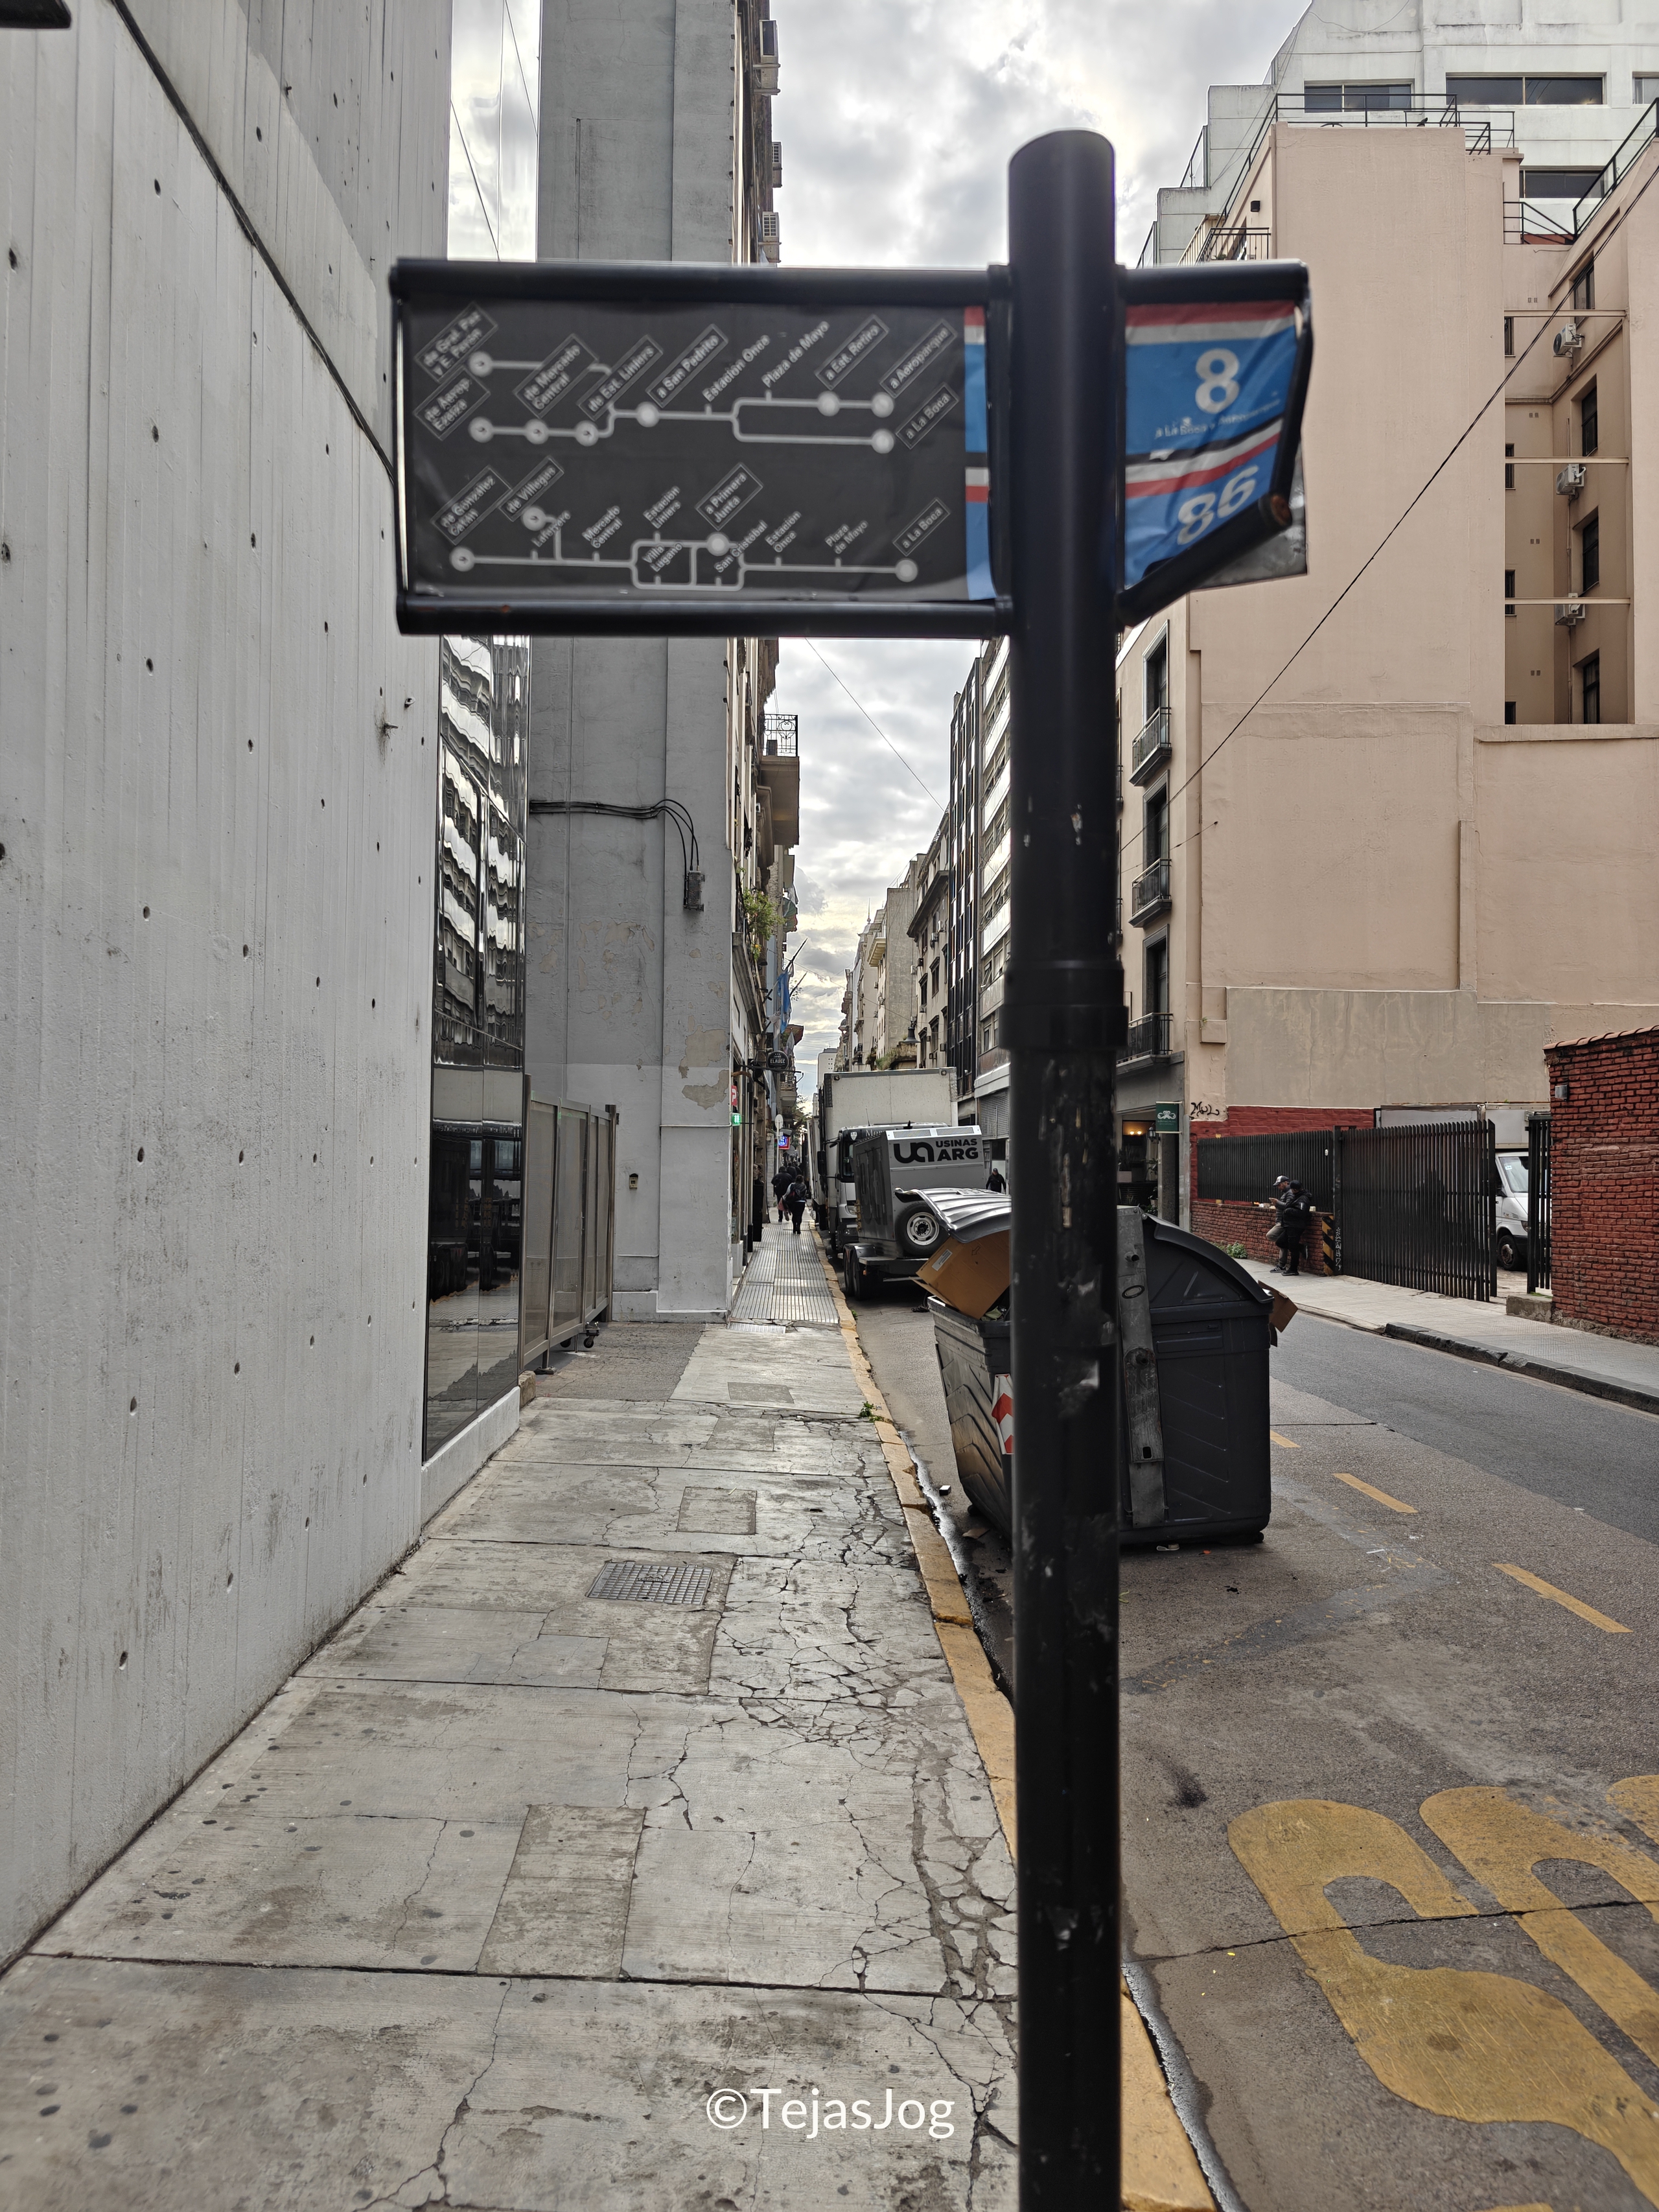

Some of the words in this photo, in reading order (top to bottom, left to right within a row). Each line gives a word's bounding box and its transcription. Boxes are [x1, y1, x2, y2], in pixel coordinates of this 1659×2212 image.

[741, 334, 771, 362] Once
[761, 359, 791, 388] Plaza
[788, 346, 804, 363] de
[798, 321, 830, 351] Mayo
[826, 369, 837, 380] a
[848, 325, 880, 356] Retiro
[523, 384, 540, 401] de
[534, 345, 580, 389] Mercado
[656, 387, 667, 399] a
[662, 368, 686, 391] San
[680, 335, 720, 373] Pedrito
[1195, 348, 1240, 414] 8
[890, 378, 901, 389] a
[588, 395, 605, 412] de
[911, 415, 927, 432] La
[923, 393, 951, 420] Boca
[704, 504, 713, 515] a
[709, 472, 747, 508] Primera
[714, 495, 741, 523] Junta
[1177, 465, 1259, 546] 86
[582, 505, 620, 542] Mercado
[651, 499, 681, 530] Liniers
[901, 539, 912, 548] a
[907, 528, 922, 542] La
[918, 507, 944, 531] Boca
[590, 517, 623, 548] Central
[773, 530, 797, 553] Once
[824, 523, 850, 547] Plaza
[833, 541, 847, 555] de
[842, 520, 869, 544] Mayo
[642, 544, 665, 564] Villa
[649, 542, 683, 572] Lugano
[713, 554, 734, 573] San
[935, 1139, 977, 1147] USINAS
[937, 1148, 979, 1161] ARG
